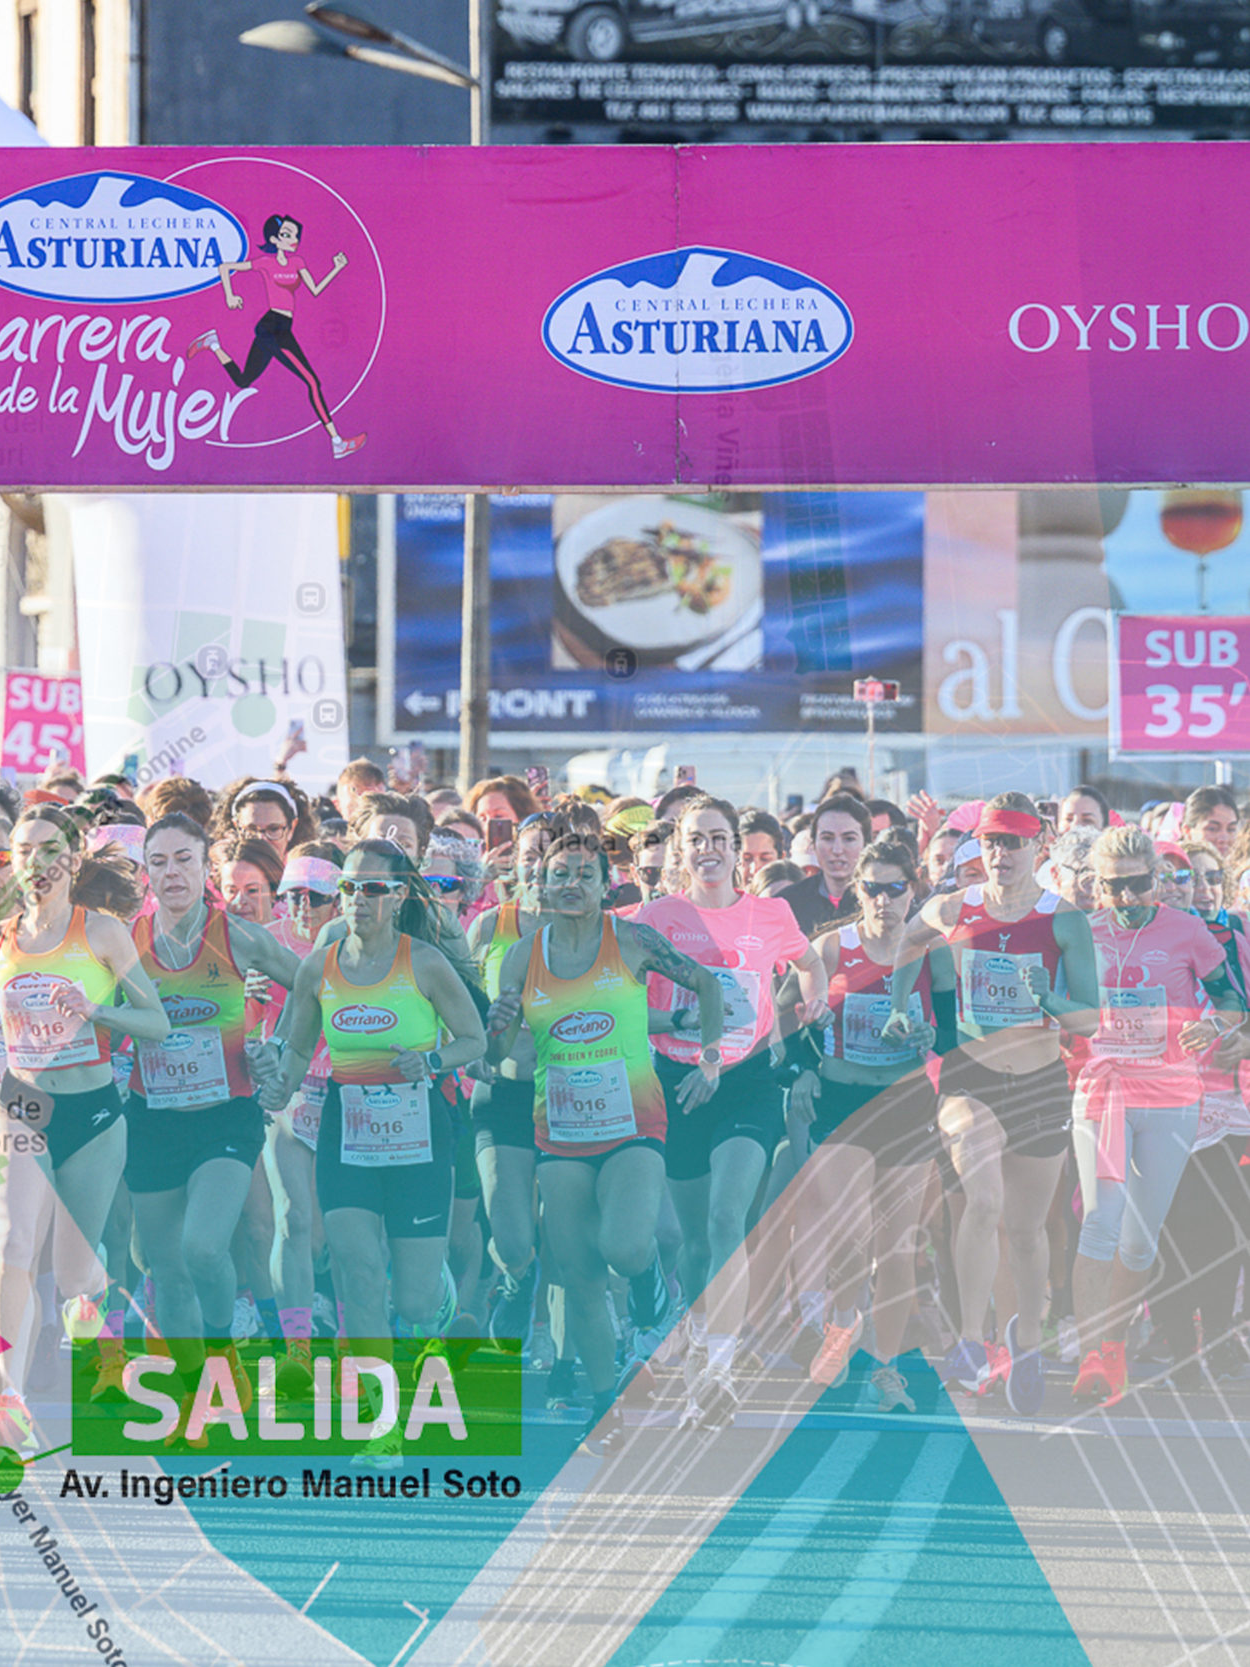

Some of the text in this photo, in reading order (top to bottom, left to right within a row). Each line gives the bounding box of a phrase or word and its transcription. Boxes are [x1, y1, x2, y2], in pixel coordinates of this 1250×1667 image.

[30, 217, 218, 231] CENTRAL LECHERA
[615, 297, 820, 312] CENTRAL LECHERA
[566, 301, 829, 354] ASTURIANA
[1008, 302, 1250, 353] OYSHO
[49, 366, 81, 414] la
[71, 356, 259, 472] Mujer
[1144, 630, 1239, 669] SUB
[938, 608, 1024, 723] al
[144, 655, 326, 702] OYSHO
[8, 677, 81, 713] SUB
[1144, 681, 1247, 738] 35'
[4, 721, 83, 767] 45'
[672, 931, 710, 943] OYSHO
[987, 984, 1018, 999] 016
[336, 1011, 392, 1027] Serrano
[556, 1018, 610, 1036] Serrano
[31, 1021, 65, 1037] 016
[166, 1062, 199, 1077] 016
[573, 1098, 607, 1113] 016
[302, 1114, 320, 1127] 01
[370, 1119, 404, 1135] 016
